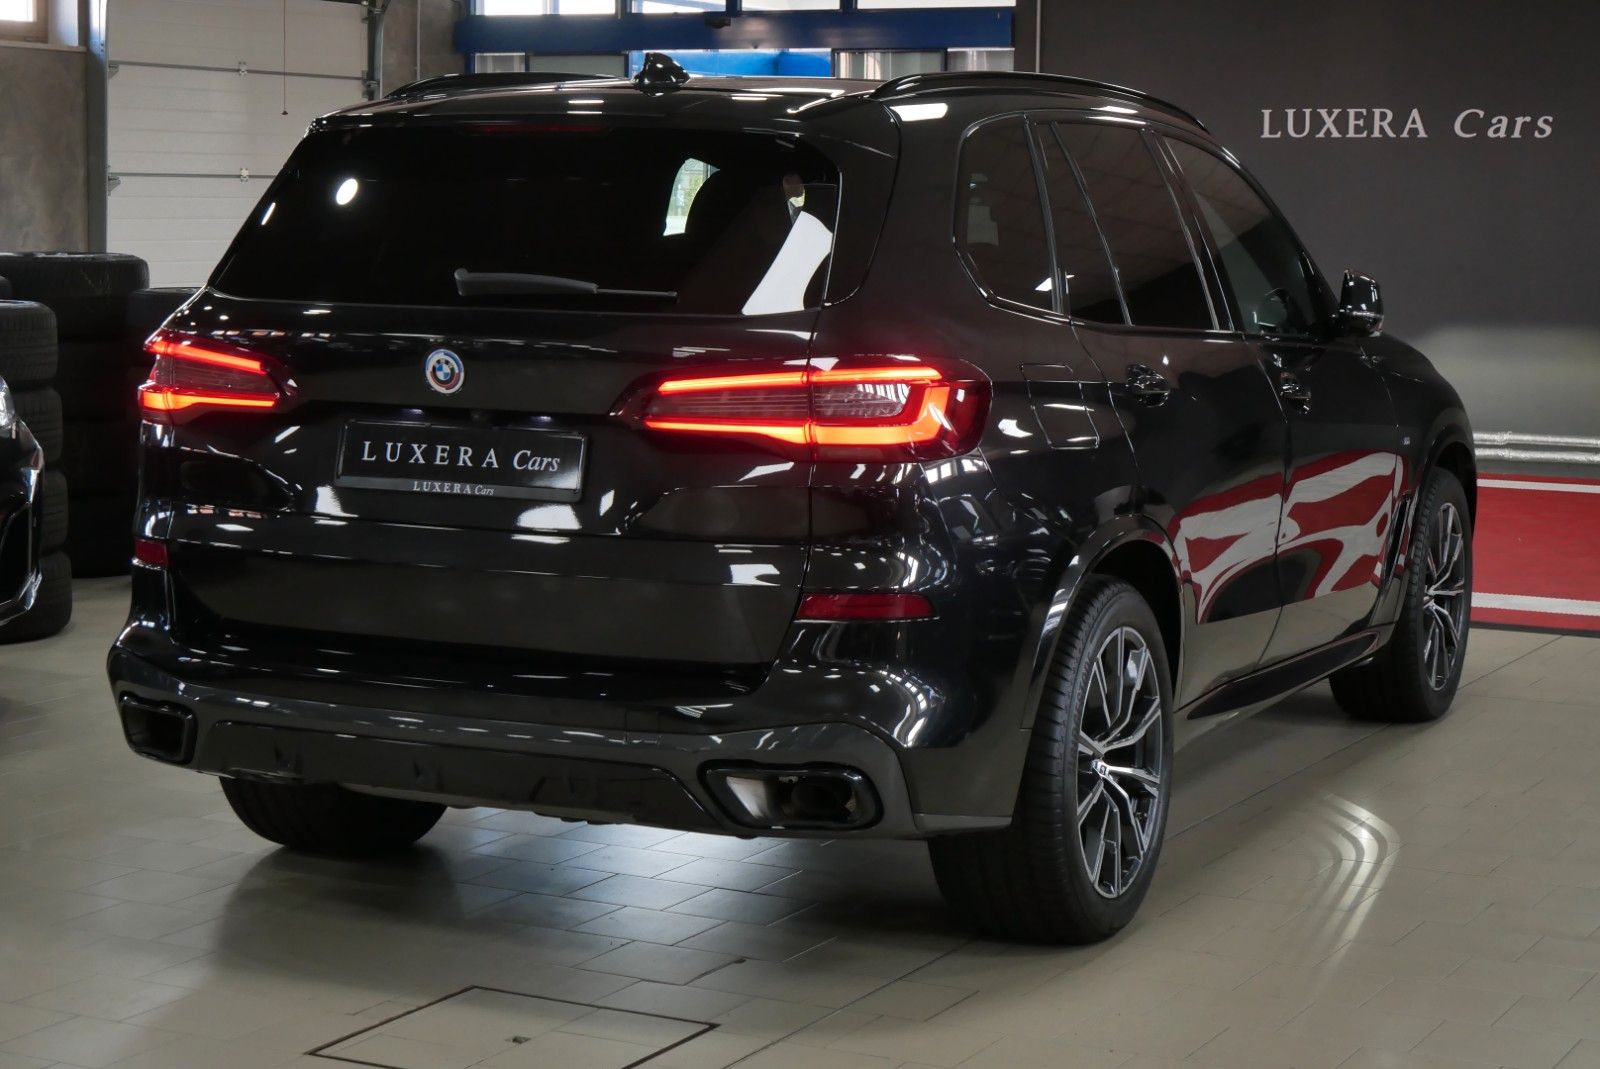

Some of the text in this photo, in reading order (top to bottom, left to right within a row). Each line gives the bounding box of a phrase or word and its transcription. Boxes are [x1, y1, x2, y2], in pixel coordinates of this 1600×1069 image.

[1260, 107, 1553, 139] LUXERA Cars
[361, 441, 561, 472] LUXERA Cars
[413, 481, 495, 497] LUXERA Cars
